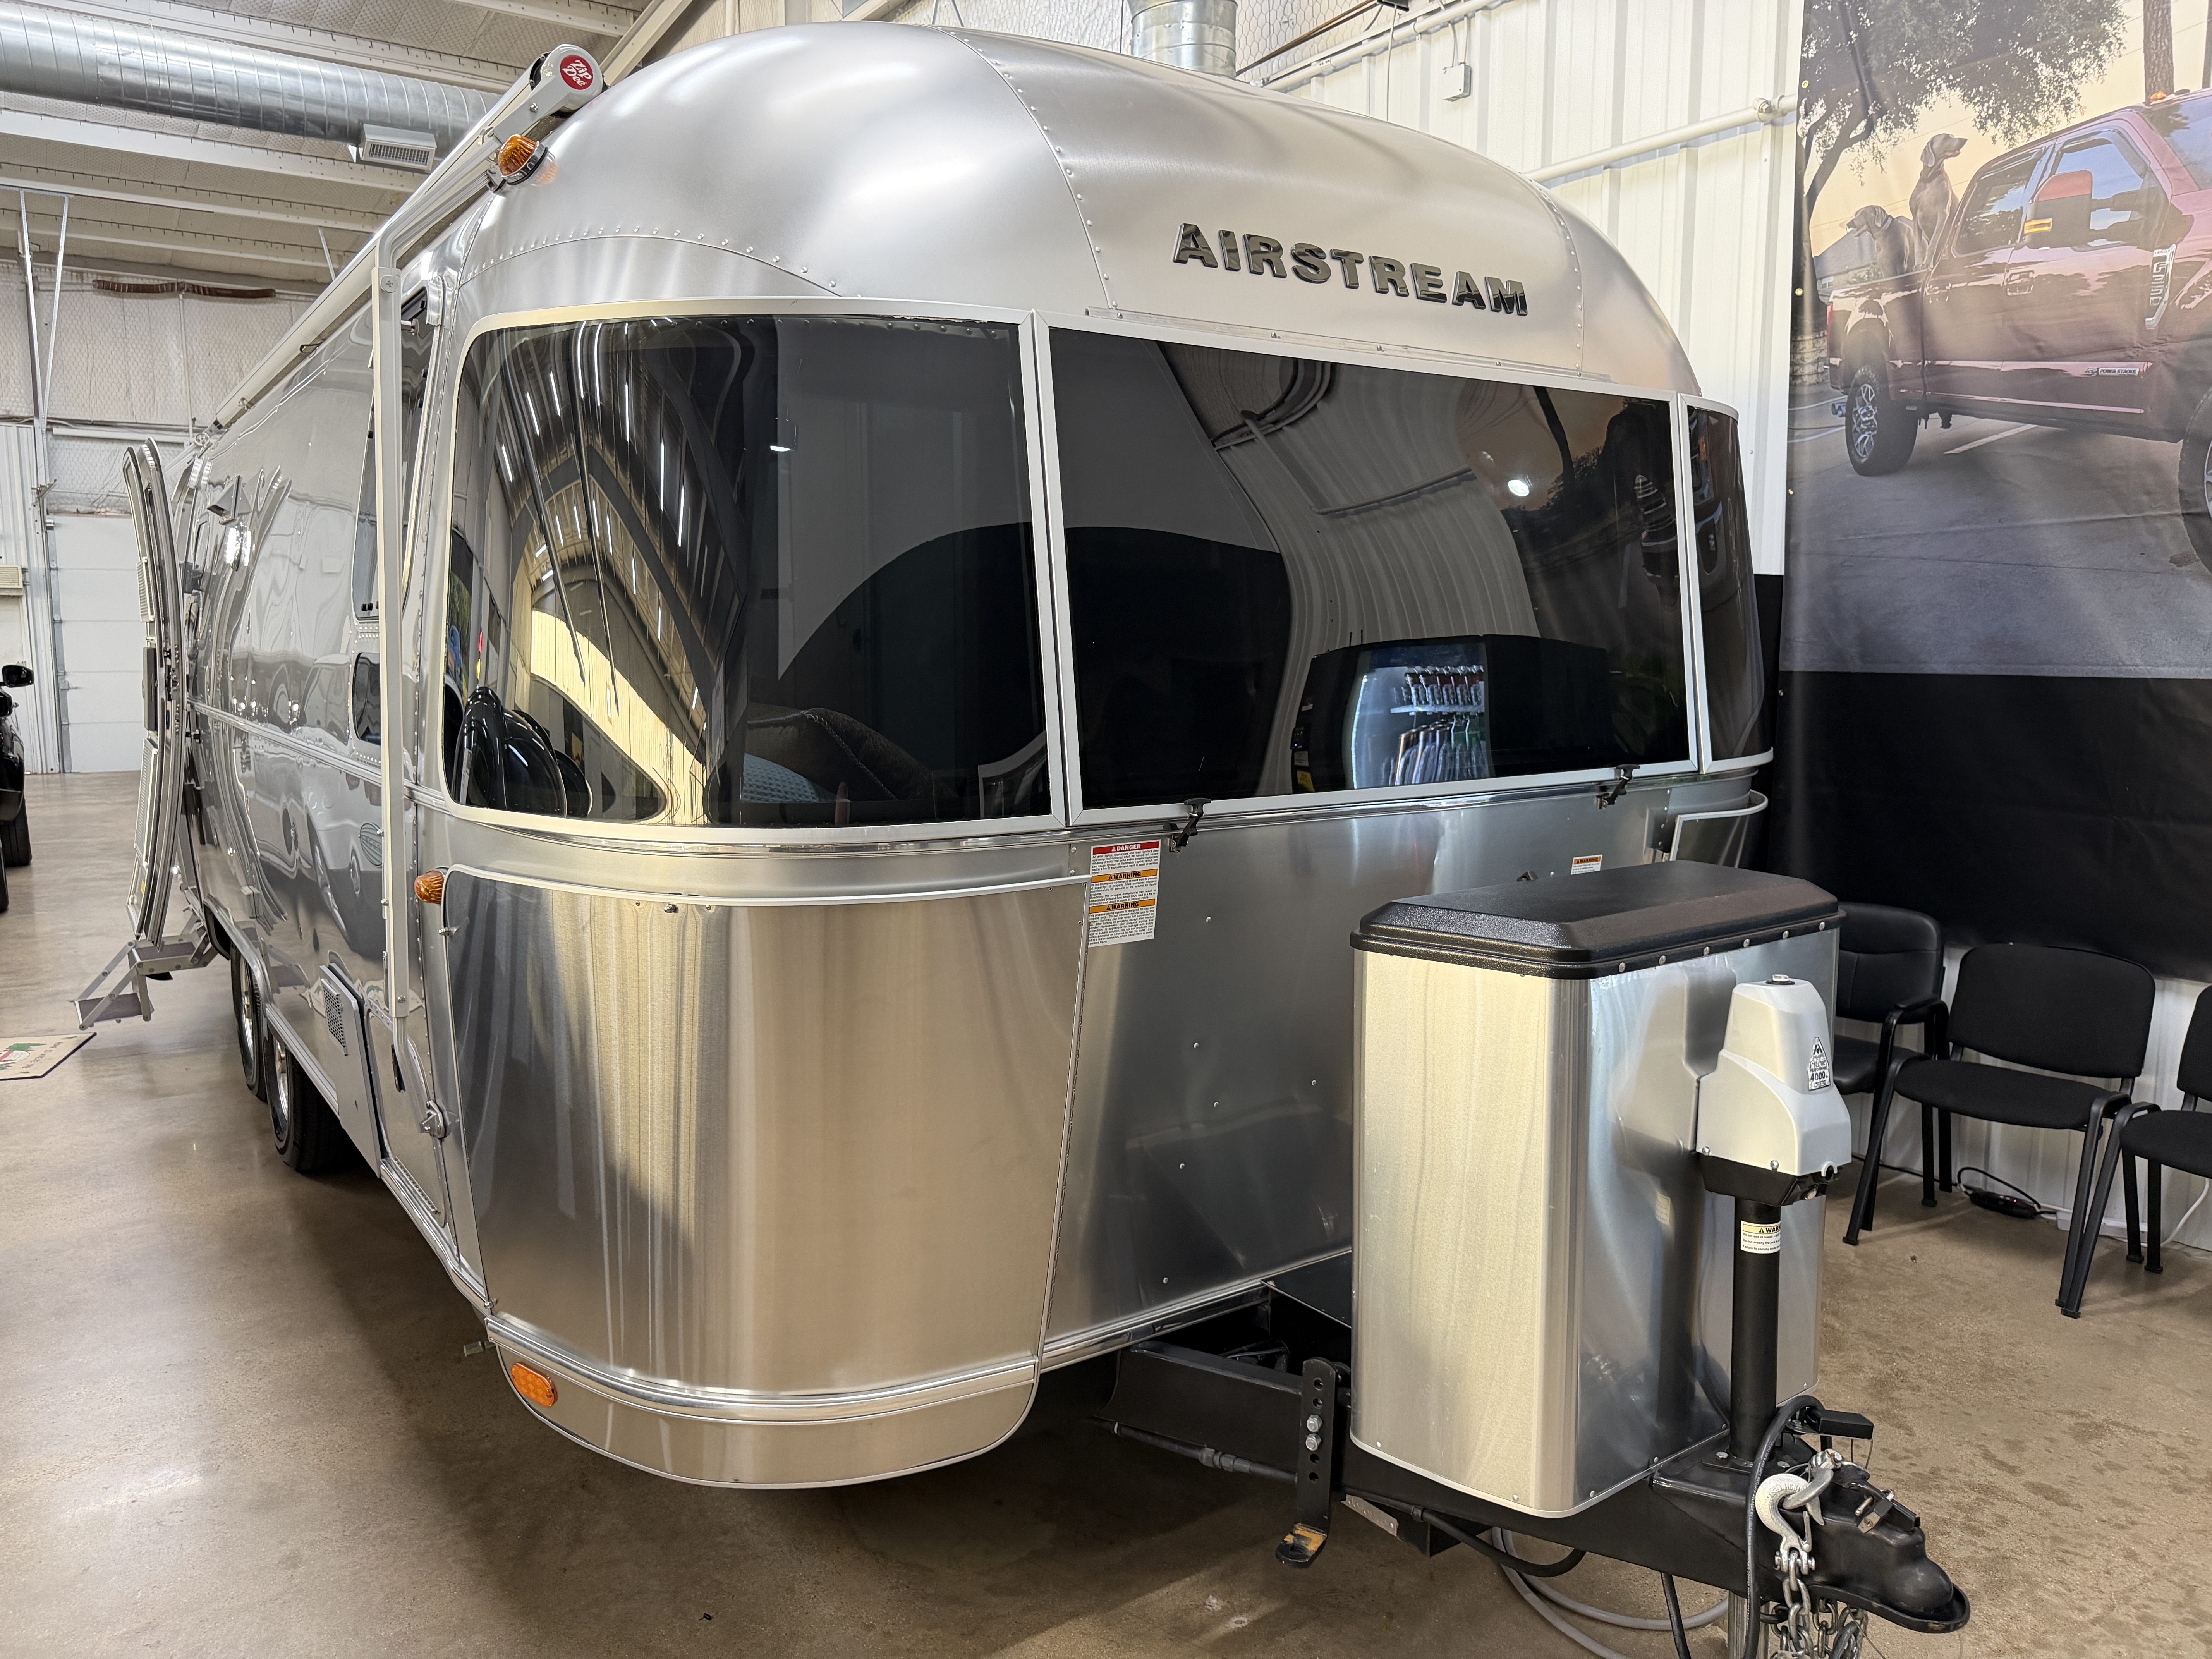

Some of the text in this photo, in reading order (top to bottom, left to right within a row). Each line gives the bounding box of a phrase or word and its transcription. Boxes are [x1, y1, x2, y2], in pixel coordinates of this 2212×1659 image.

[562, 65, 585, 86] Dee
[570, 60, 592, 79] Zip
[1173, 223, 1528, 317] AIRSTREAM
[1810, 1071, 1825, 1081] 4000
